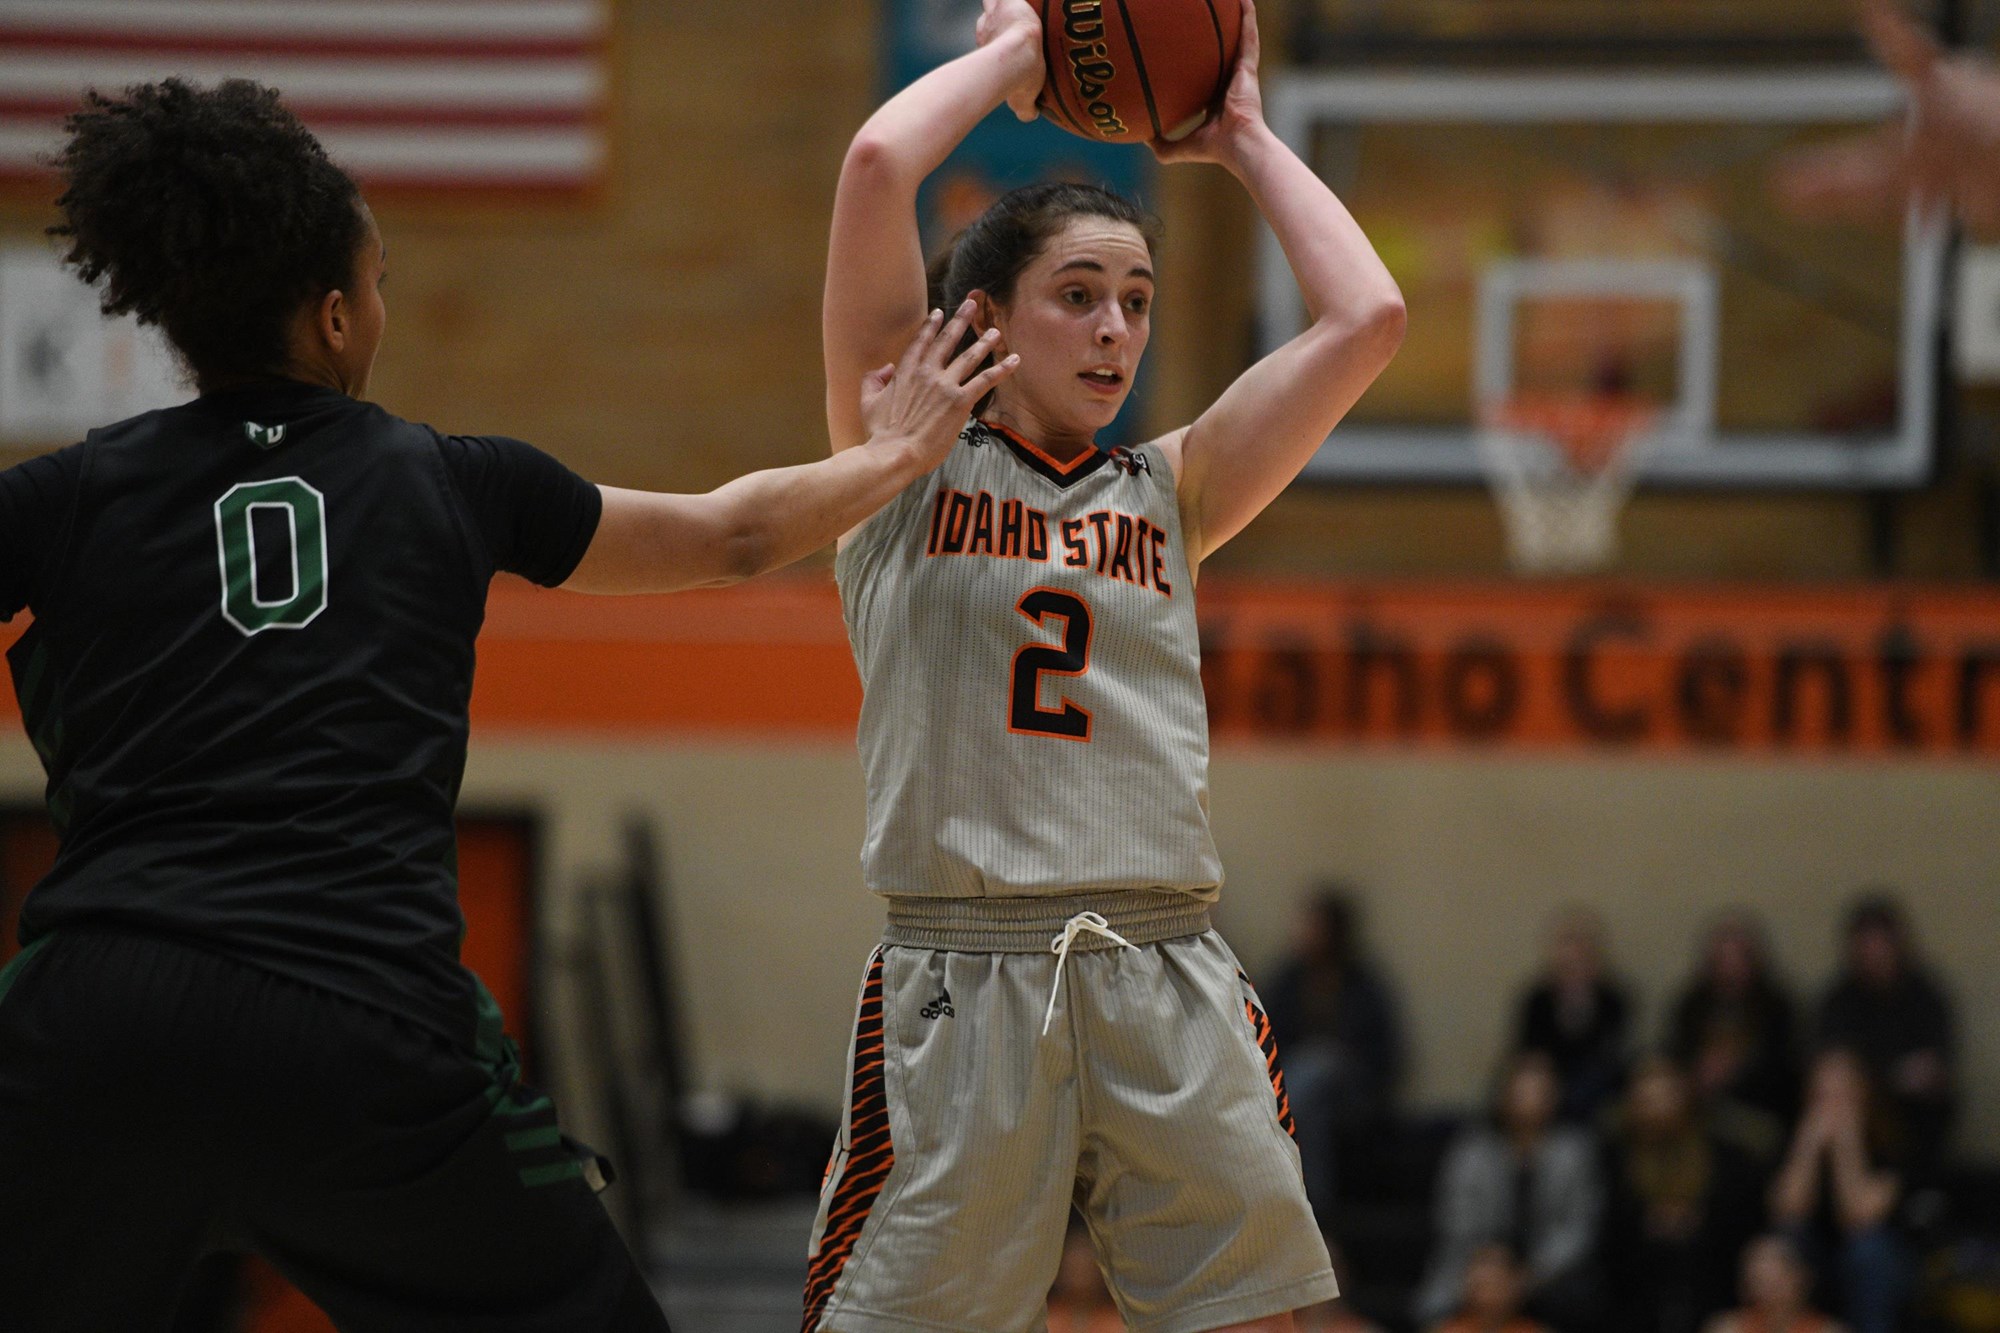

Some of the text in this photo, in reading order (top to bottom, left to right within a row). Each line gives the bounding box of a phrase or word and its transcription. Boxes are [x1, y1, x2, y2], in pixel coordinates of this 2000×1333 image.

[1061, 0, 1129, 137] Wilson
[213, 475, 329, 638] 0
[926, 488, 1173, 600] IDAHO STATE
[1006, 585, 1094, 744] 2
[1198, 592, 1523, 742] aho
